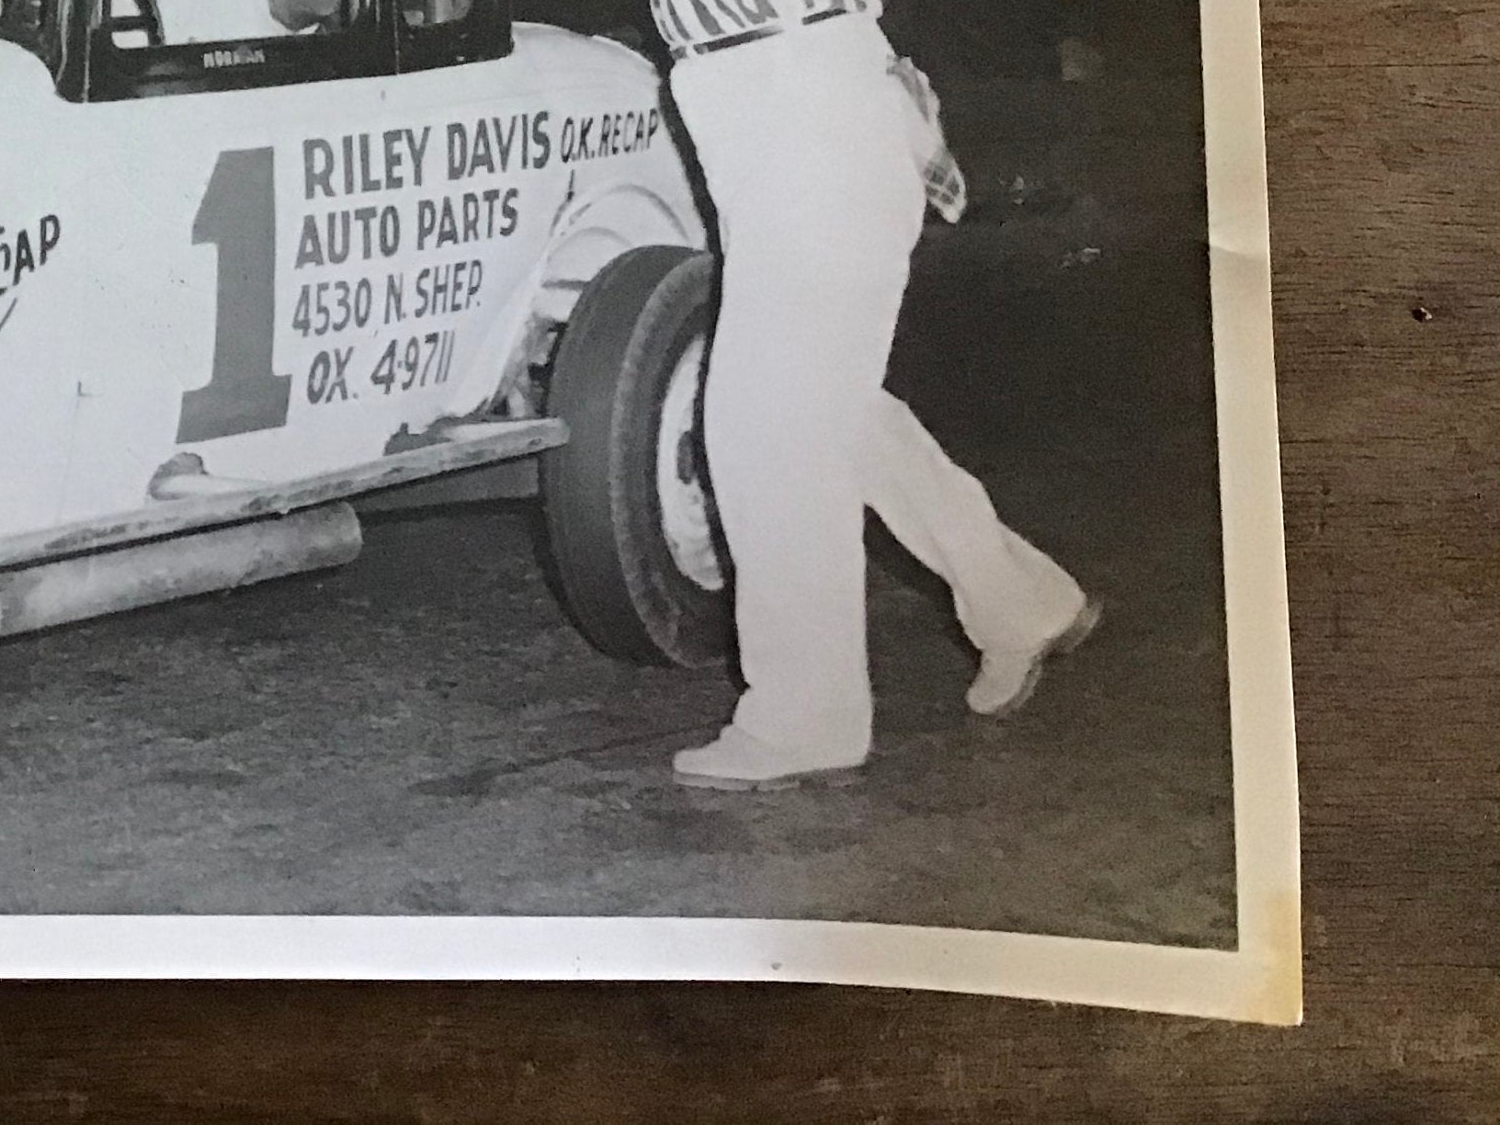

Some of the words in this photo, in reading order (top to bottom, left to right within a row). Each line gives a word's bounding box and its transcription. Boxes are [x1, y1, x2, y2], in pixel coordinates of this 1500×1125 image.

[303, 126, 431, 200] RILEY
[446, 111, 550, 181] DAVIS
[294, 205, 401, 270] AUTO
[417, 188, 519, 251] PARTS
[175, 146, 293, 444] 1
[292, 277, 372, 338] 4530
[384, 272, 407, 325] N.
[415, 259, 483, 319] SHEP.
[307, 346, 359, 405] OX.
